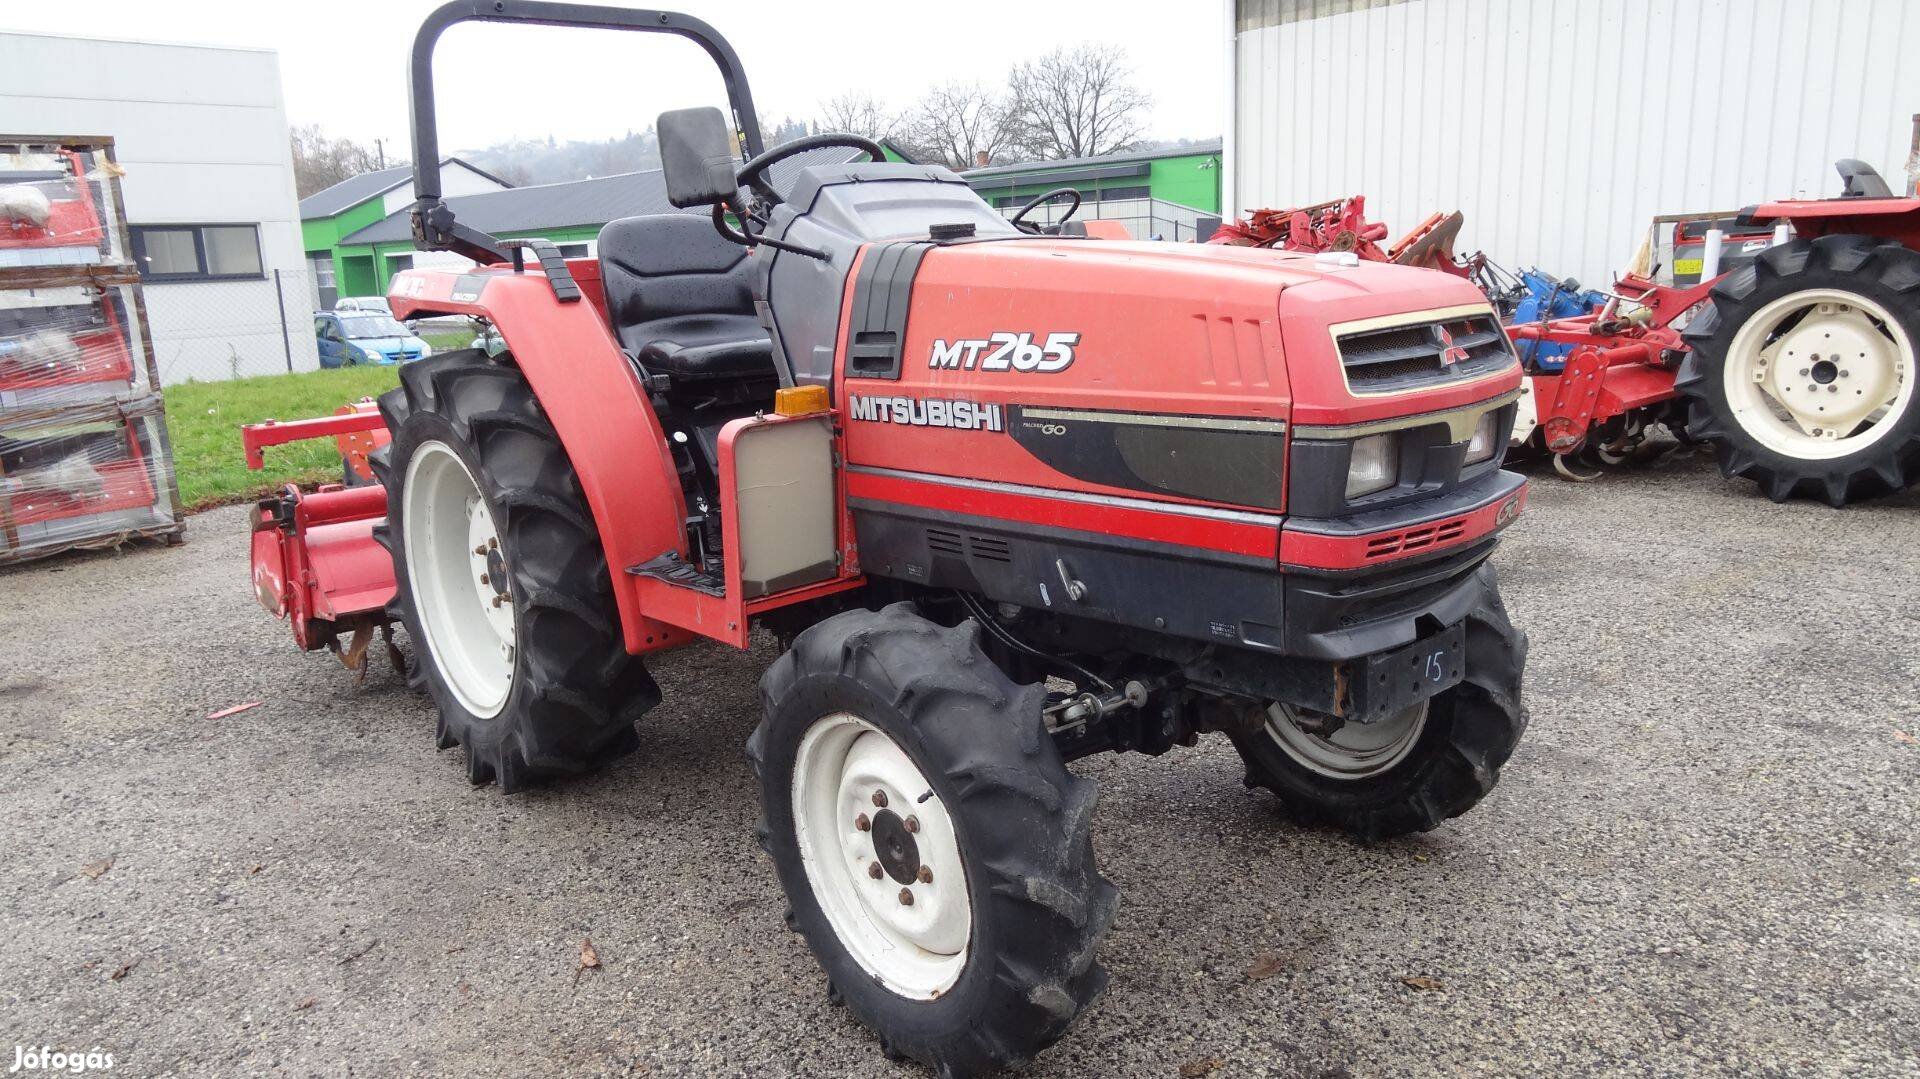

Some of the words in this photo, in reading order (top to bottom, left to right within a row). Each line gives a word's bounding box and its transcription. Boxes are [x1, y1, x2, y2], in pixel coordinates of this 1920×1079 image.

[929, 332, 1082, 373] MT265
[850, 394, 1005, 433] MITSUBISHI
[1042, 424, 1067, 435] GO
[1425, 651, 1444, 682] 15
